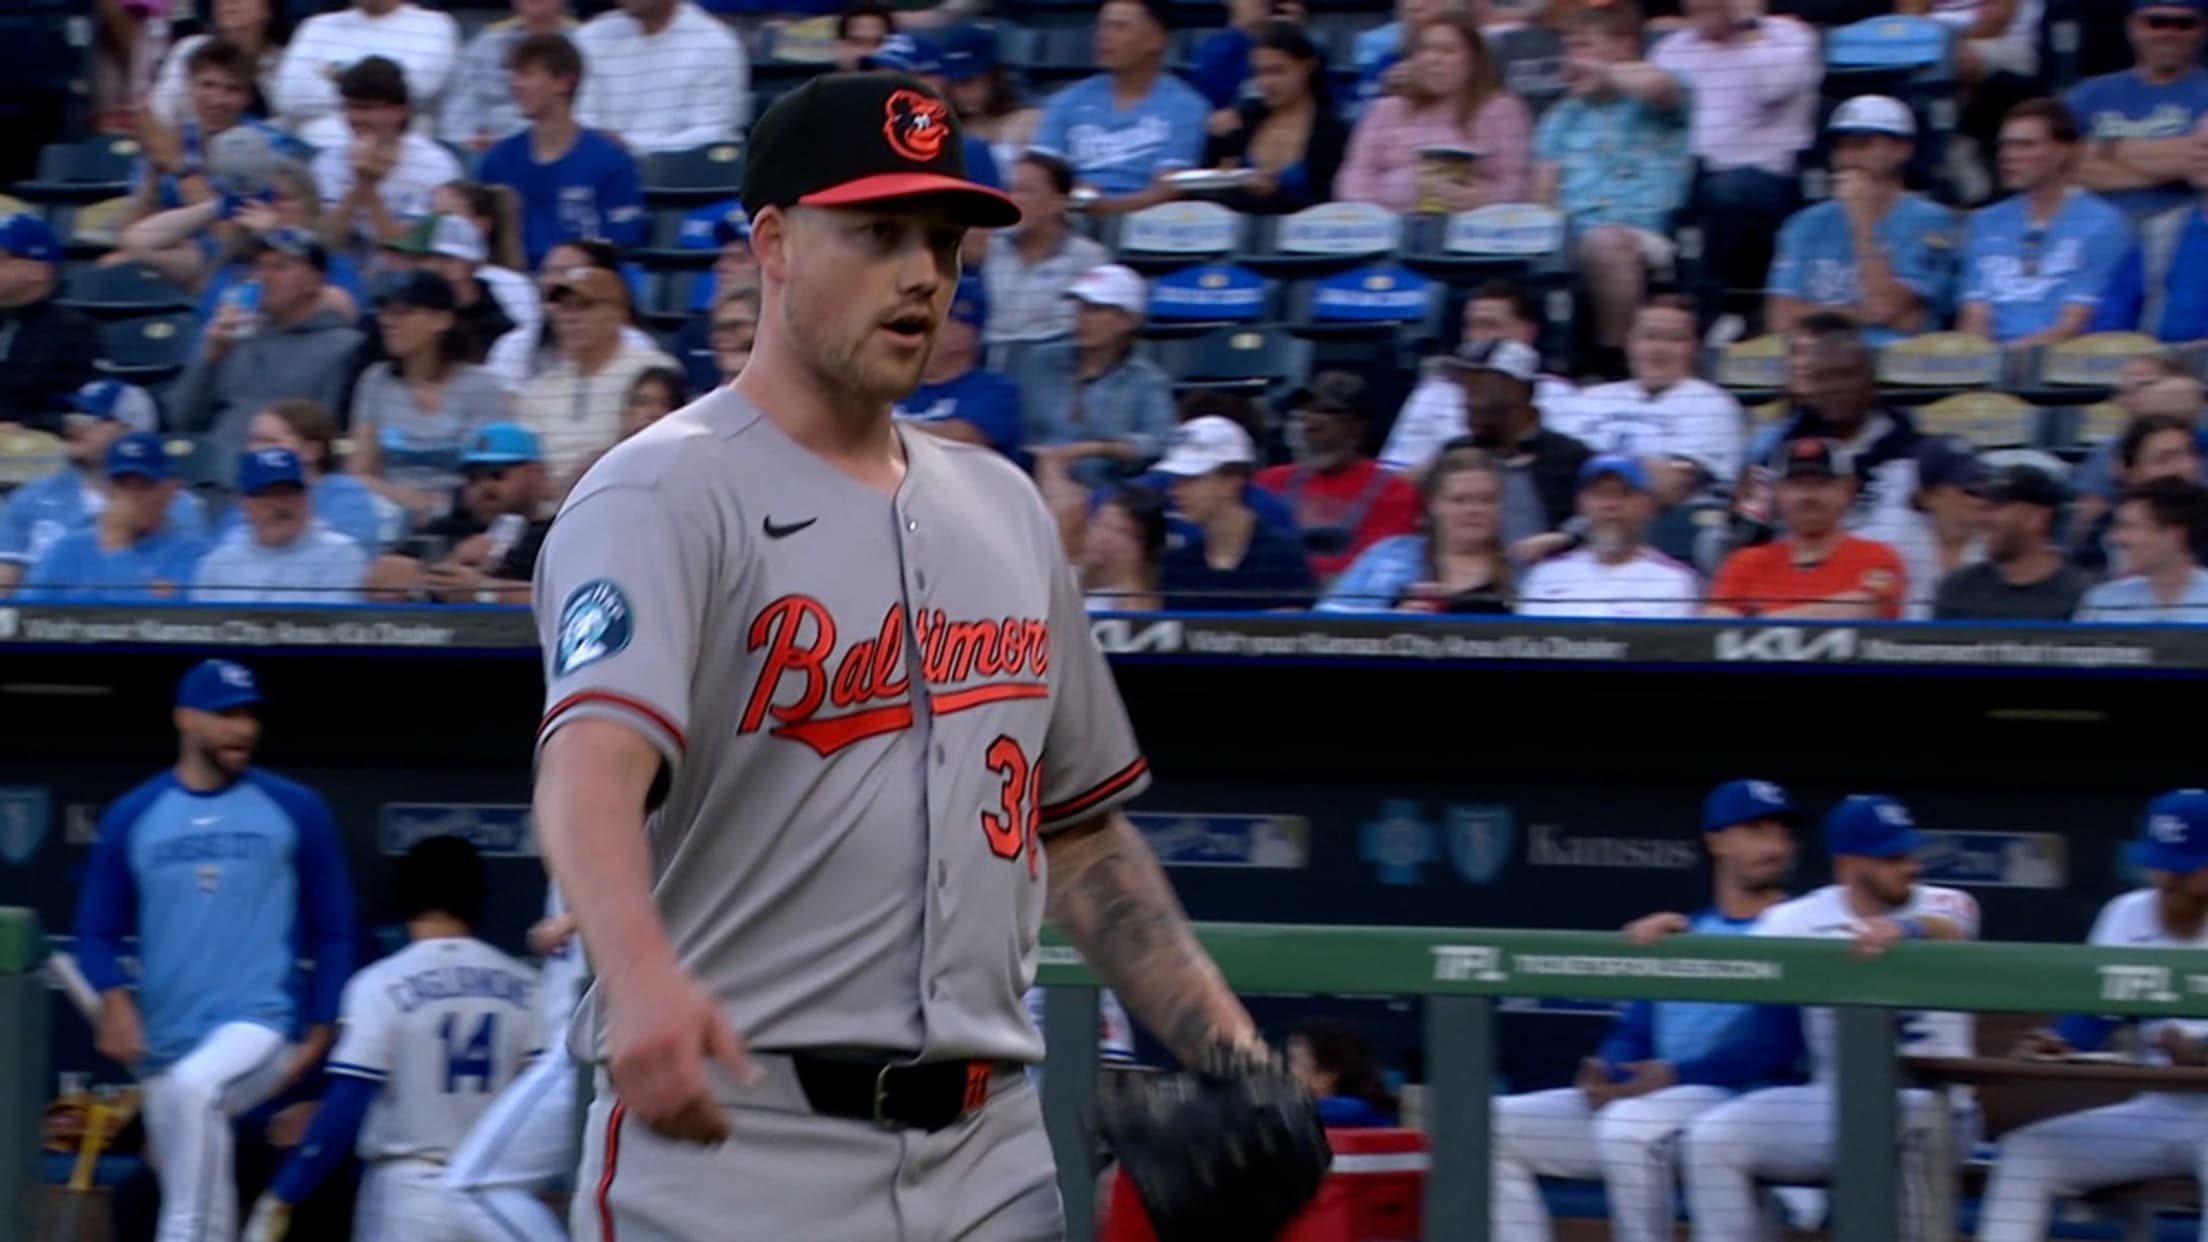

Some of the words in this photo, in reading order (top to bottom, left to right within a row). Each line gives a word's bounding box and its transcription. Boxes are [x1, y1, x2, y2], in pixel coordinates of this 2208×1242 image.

[1713, 626, 1857, 662] KIA
[1527, 823, 1699, 869] Kansas
[439, 1011, 498, 1094] 14
